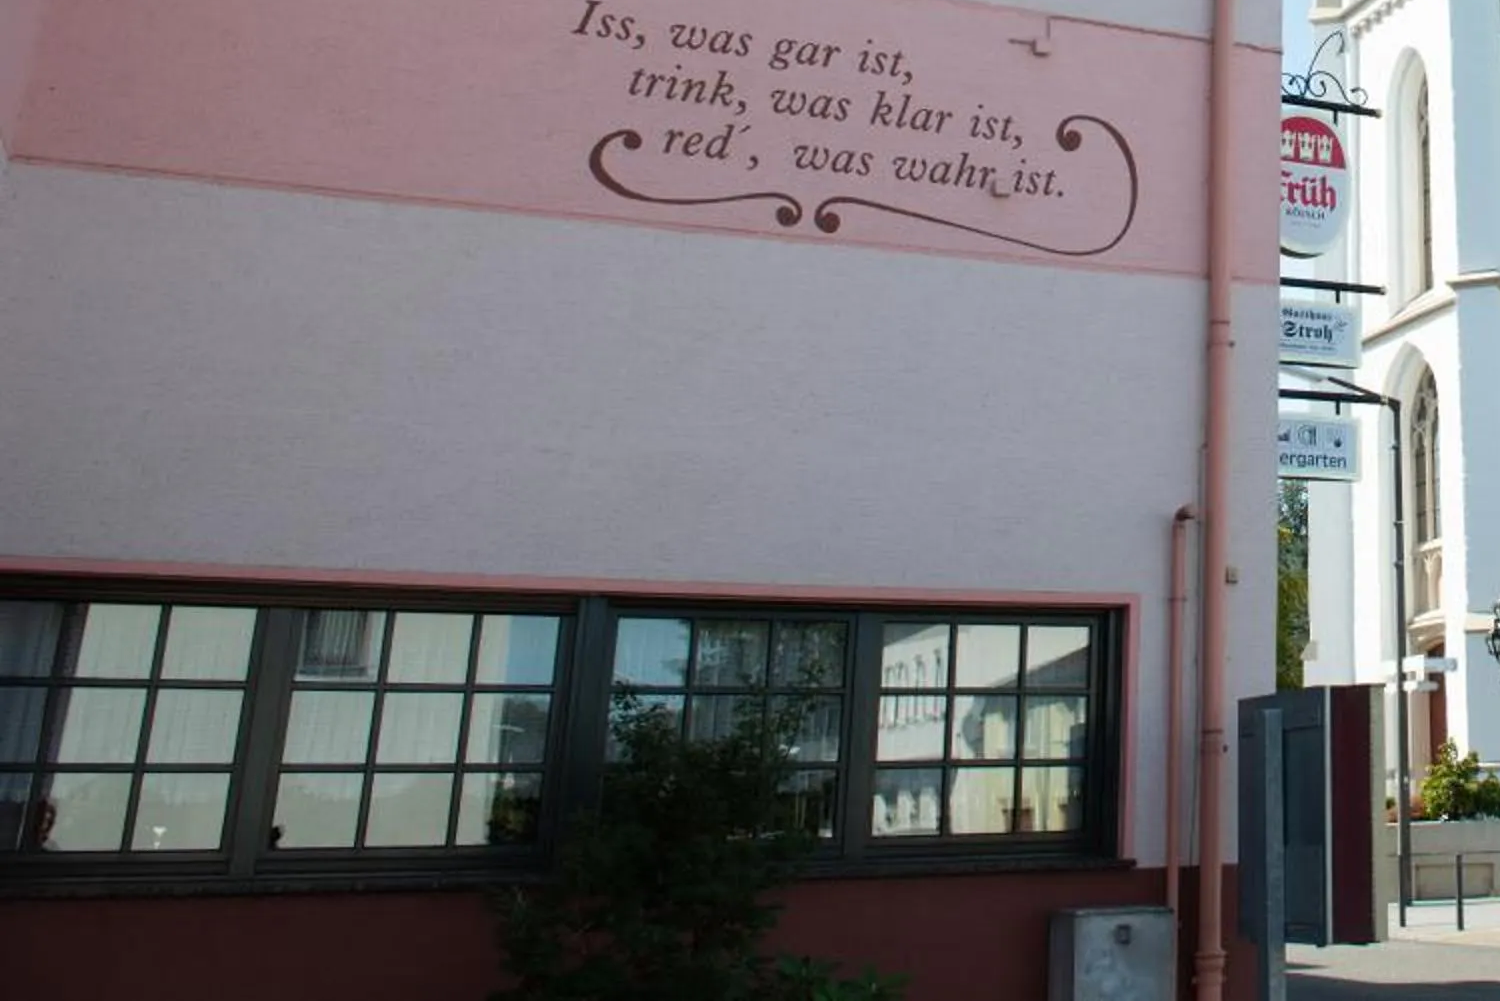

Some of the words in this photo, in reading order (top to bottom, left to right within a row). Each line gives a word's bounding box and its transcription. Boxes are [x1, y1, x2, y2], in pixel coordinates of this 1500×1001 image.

[571, 0, 645, 49] Iss,
[670, 24, 753, 57] was
[768, 39, 841, 71] gar
[858, 39, 913, 86] ist,
[629, 65, 746, 115] trink,
[770, 90, 851, 122] was
[870, 90, 953, 134] klar
[970, 104, 1022, 149] ist,
[794, 145, 874, 176] was
[892, 152, 996, 190] wahr
[1013, 159, 1064, 198] ist.
[1283, 320, 1333, 343] Stroh
[1279, 452, 1347, 468] ergarten
